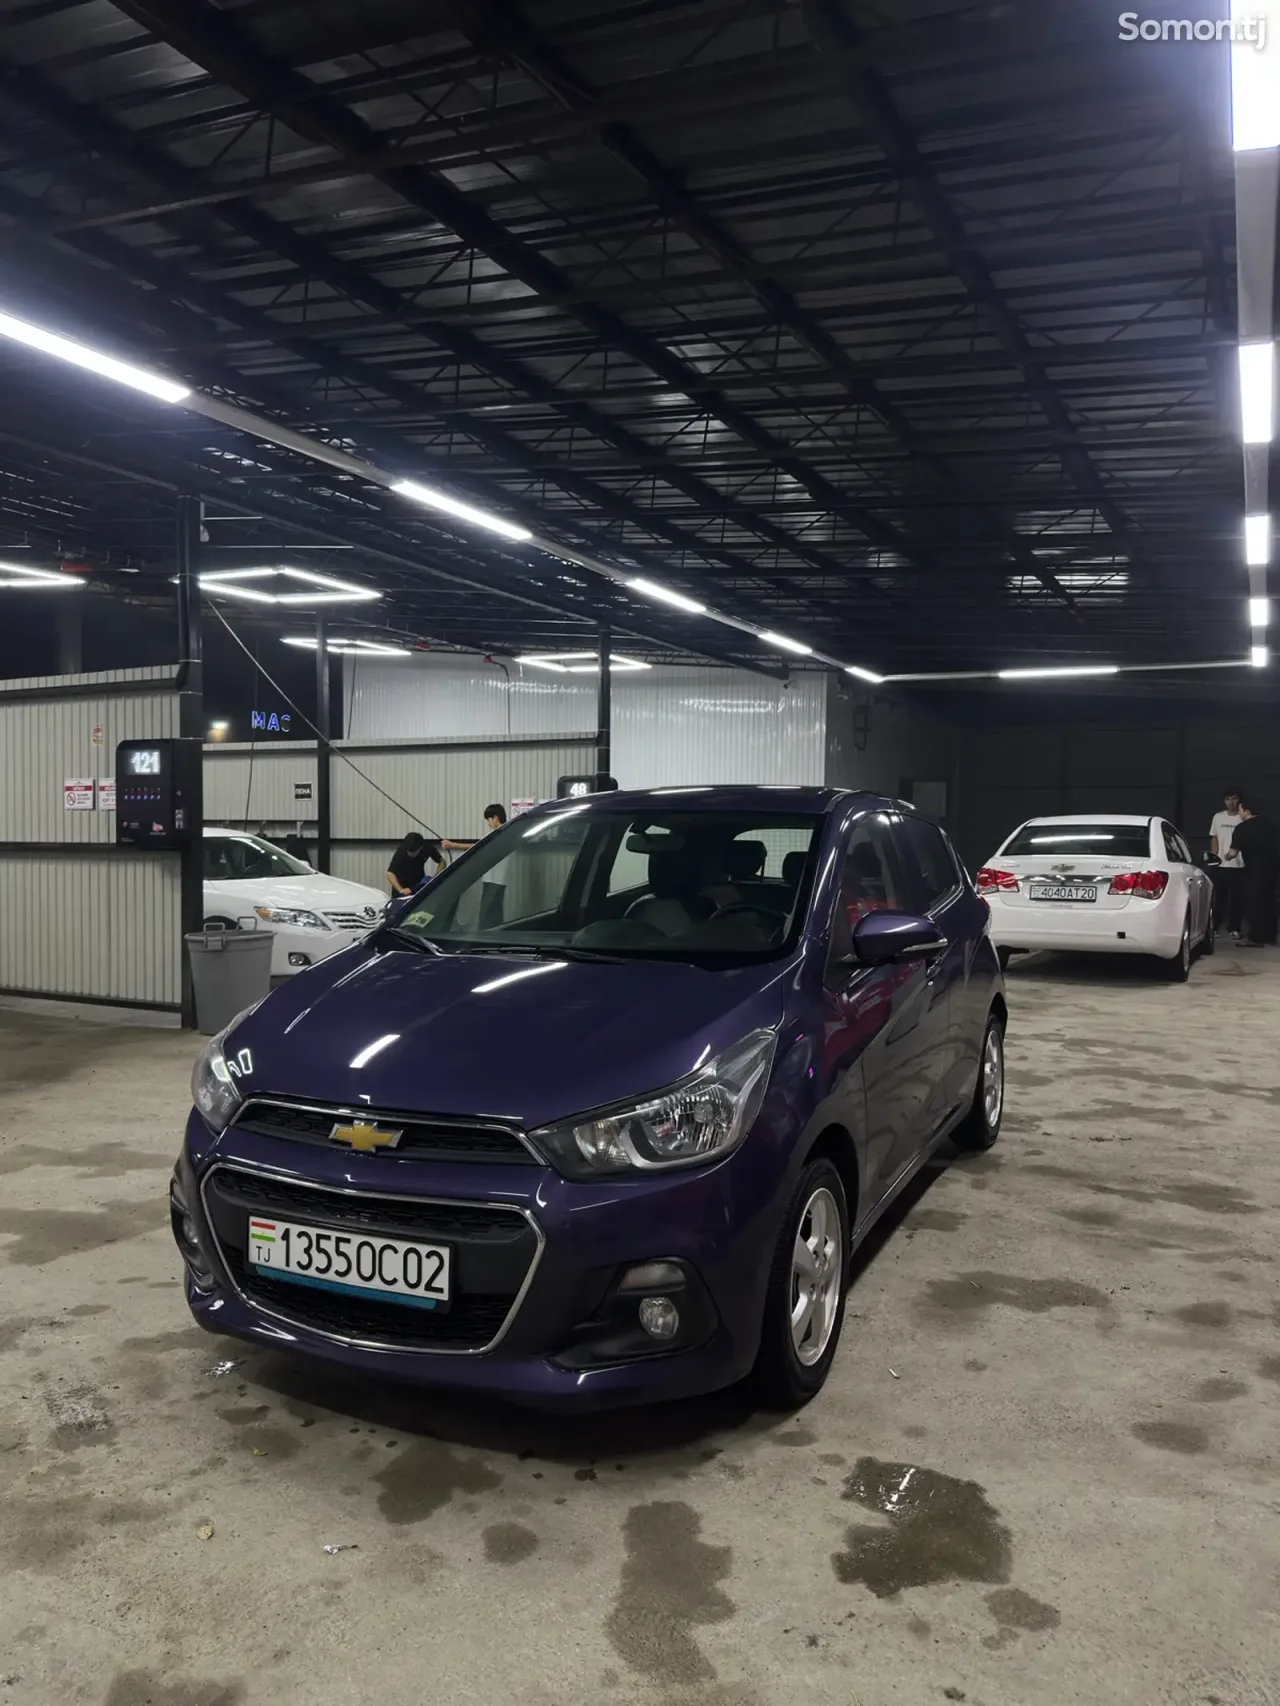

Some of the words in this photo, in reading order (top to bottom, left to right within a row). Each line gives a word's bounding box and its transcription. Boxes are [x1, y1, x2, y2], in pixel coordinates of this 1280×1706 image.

[131, 751, 160, 773] 121
[570, 783, 587, 796] 48
[1041, 887, 1094, 899] 4040AT20
[256, 1245, 271, 1263] TJ
